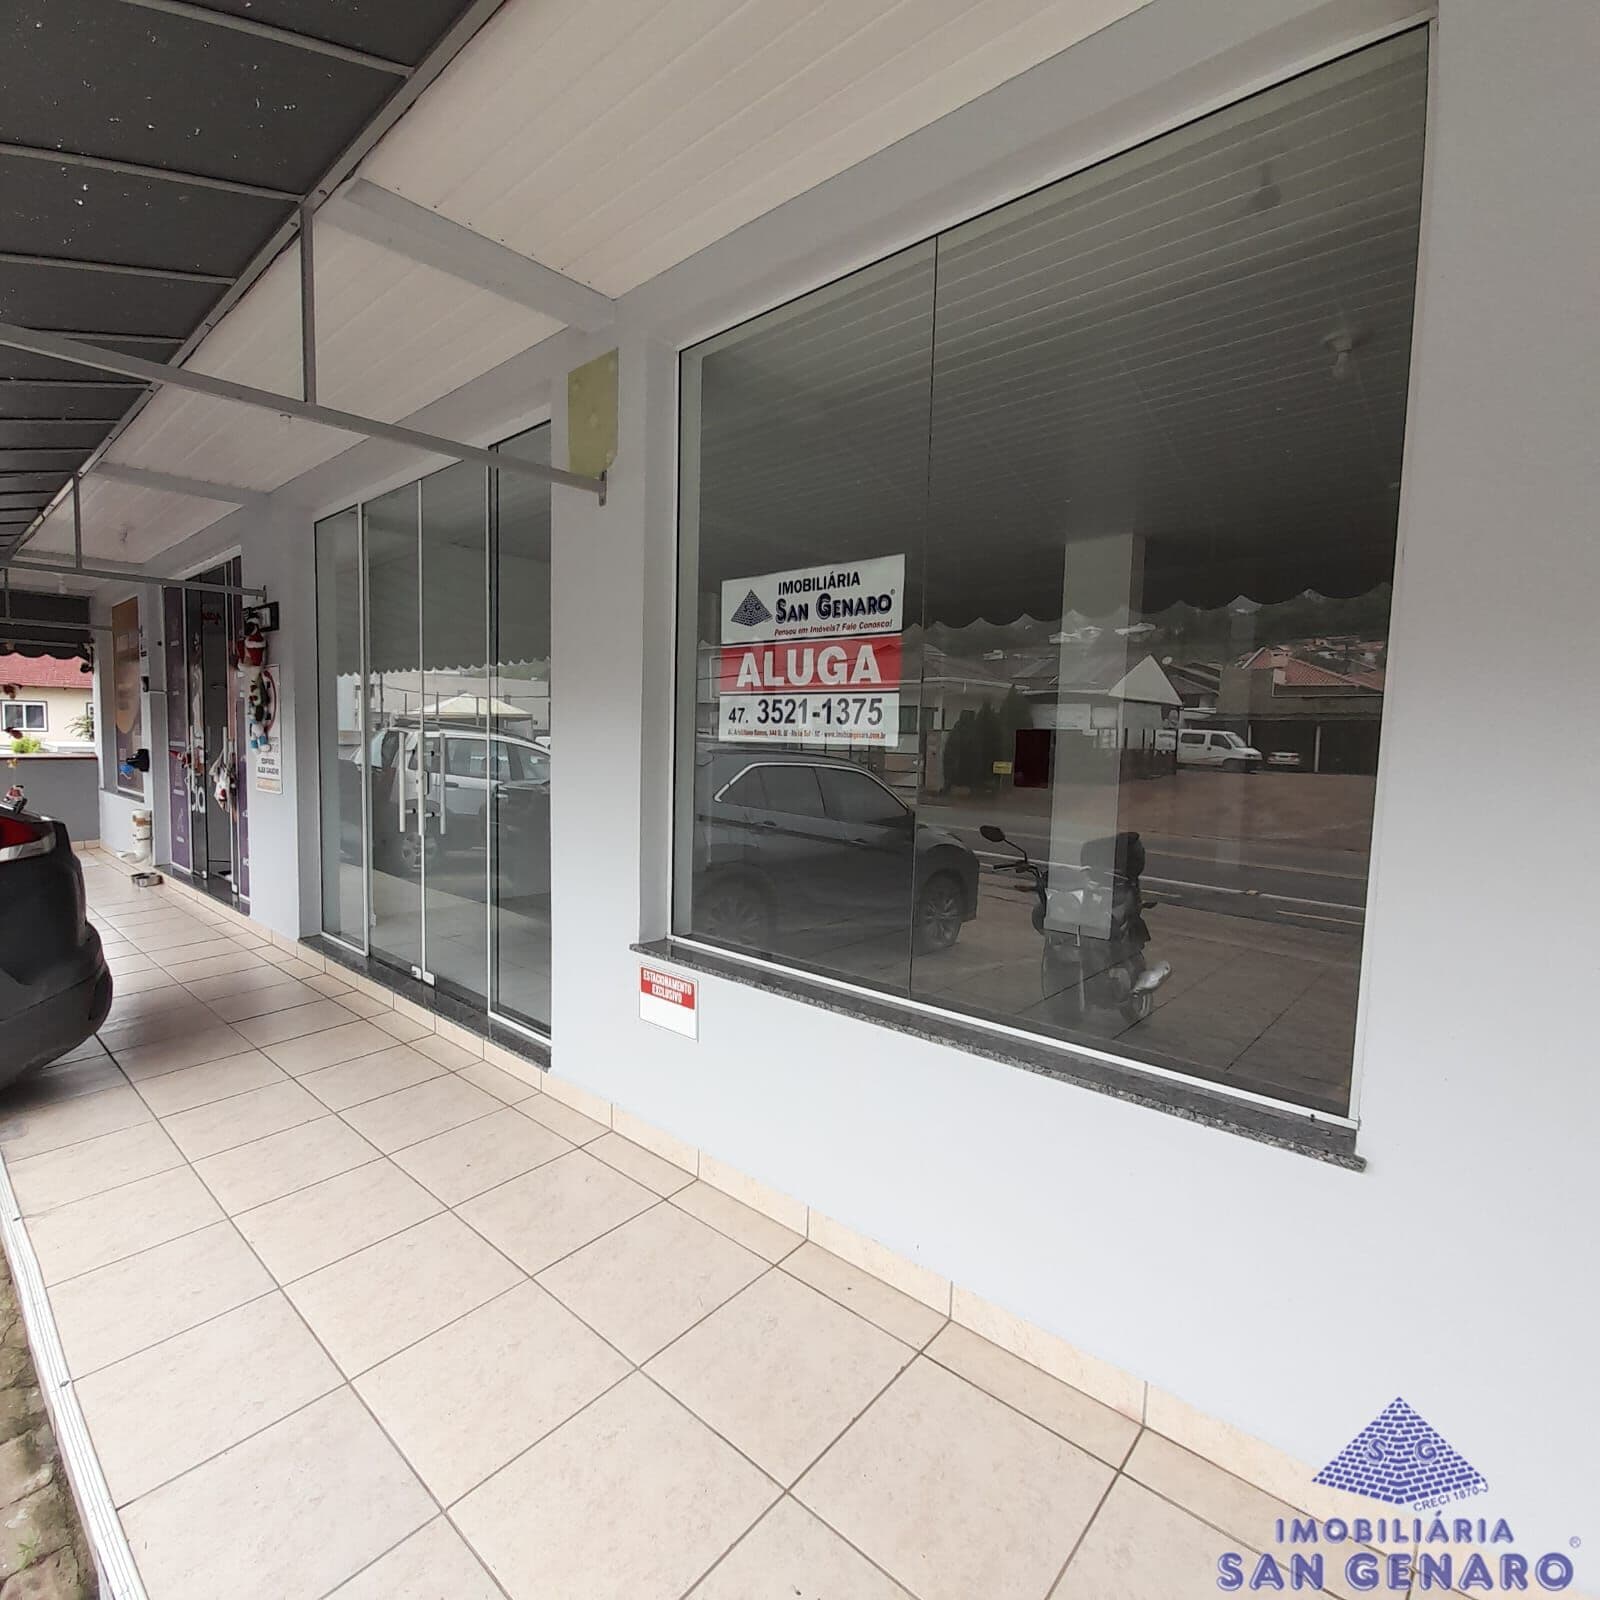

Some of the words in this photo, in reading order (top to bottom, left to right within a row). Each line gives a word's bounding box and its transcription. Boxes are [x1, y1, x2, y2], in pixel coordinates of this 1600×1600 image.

[778, 571, 861, 596] IMOBILIÁRIA
[776, 598, 809, 625] SAN
[816, 593, 893, 620] GENARO
[774, 626, 797, 637] Pensou
[810, 623, 841, 634] Imóveis?
[859, 619, 893, 631] Conosco!
[736, 644, 882, 688] ALUGA
[728, 708, 749, 724] 47.
[757, 697, 883, 726] 3521-1375
[643, 969, 693, 996] ESTACIONAMENTO
[651, 983, 683, 1004] EXCLUSIVO
